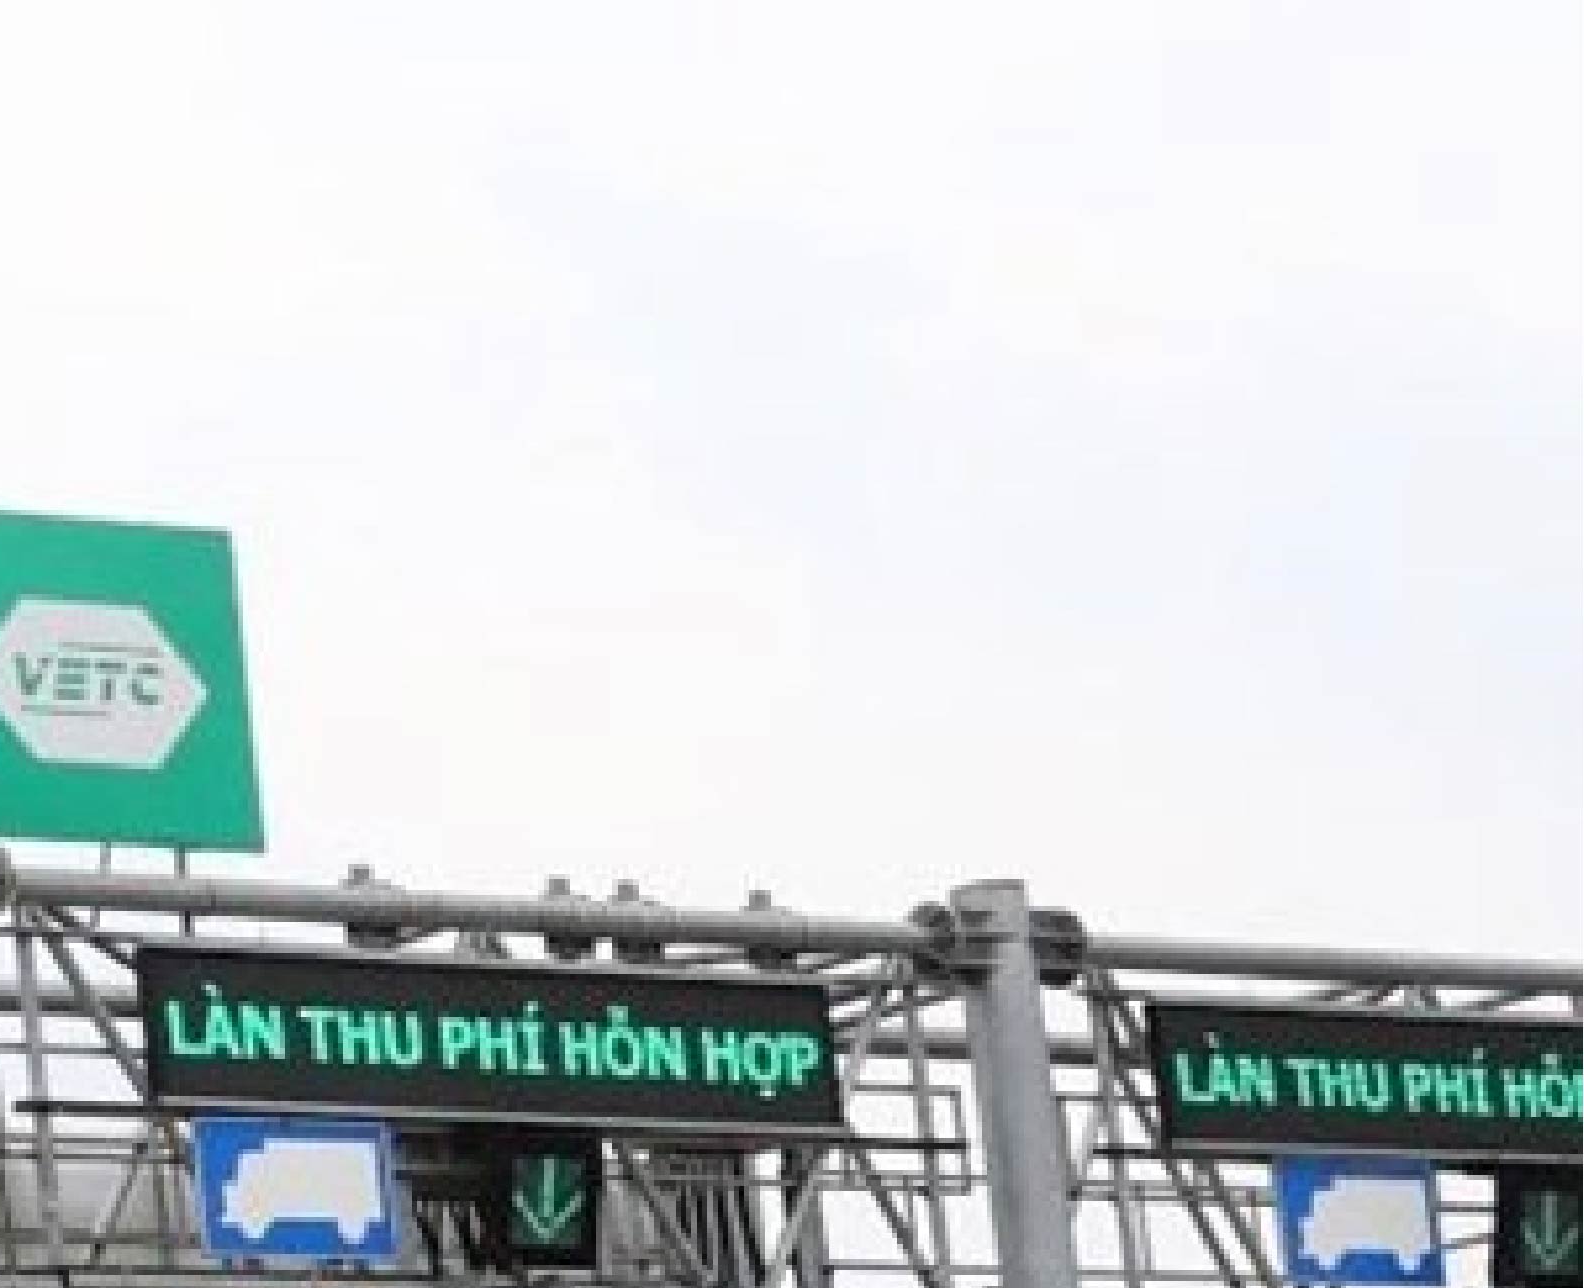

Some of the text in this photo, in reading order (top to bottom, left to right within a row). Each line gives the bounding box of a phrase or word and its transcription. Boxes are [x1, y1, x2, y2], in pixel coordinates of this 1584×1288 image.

[10, 650, 165, 709] VETC
[166, 982, 287, 1060] LÀN
[300, 1004, 425, 1066] THU
[441, 1000, 550, 1076] PHÍ
[702, 1028, 825, 1102] HỢP
[1174, 1030, 1278, 1108] LÀN
[1284, 1056, 1392, 1110] THU
[1401, 1046, 1493, 1120] PHÍ
